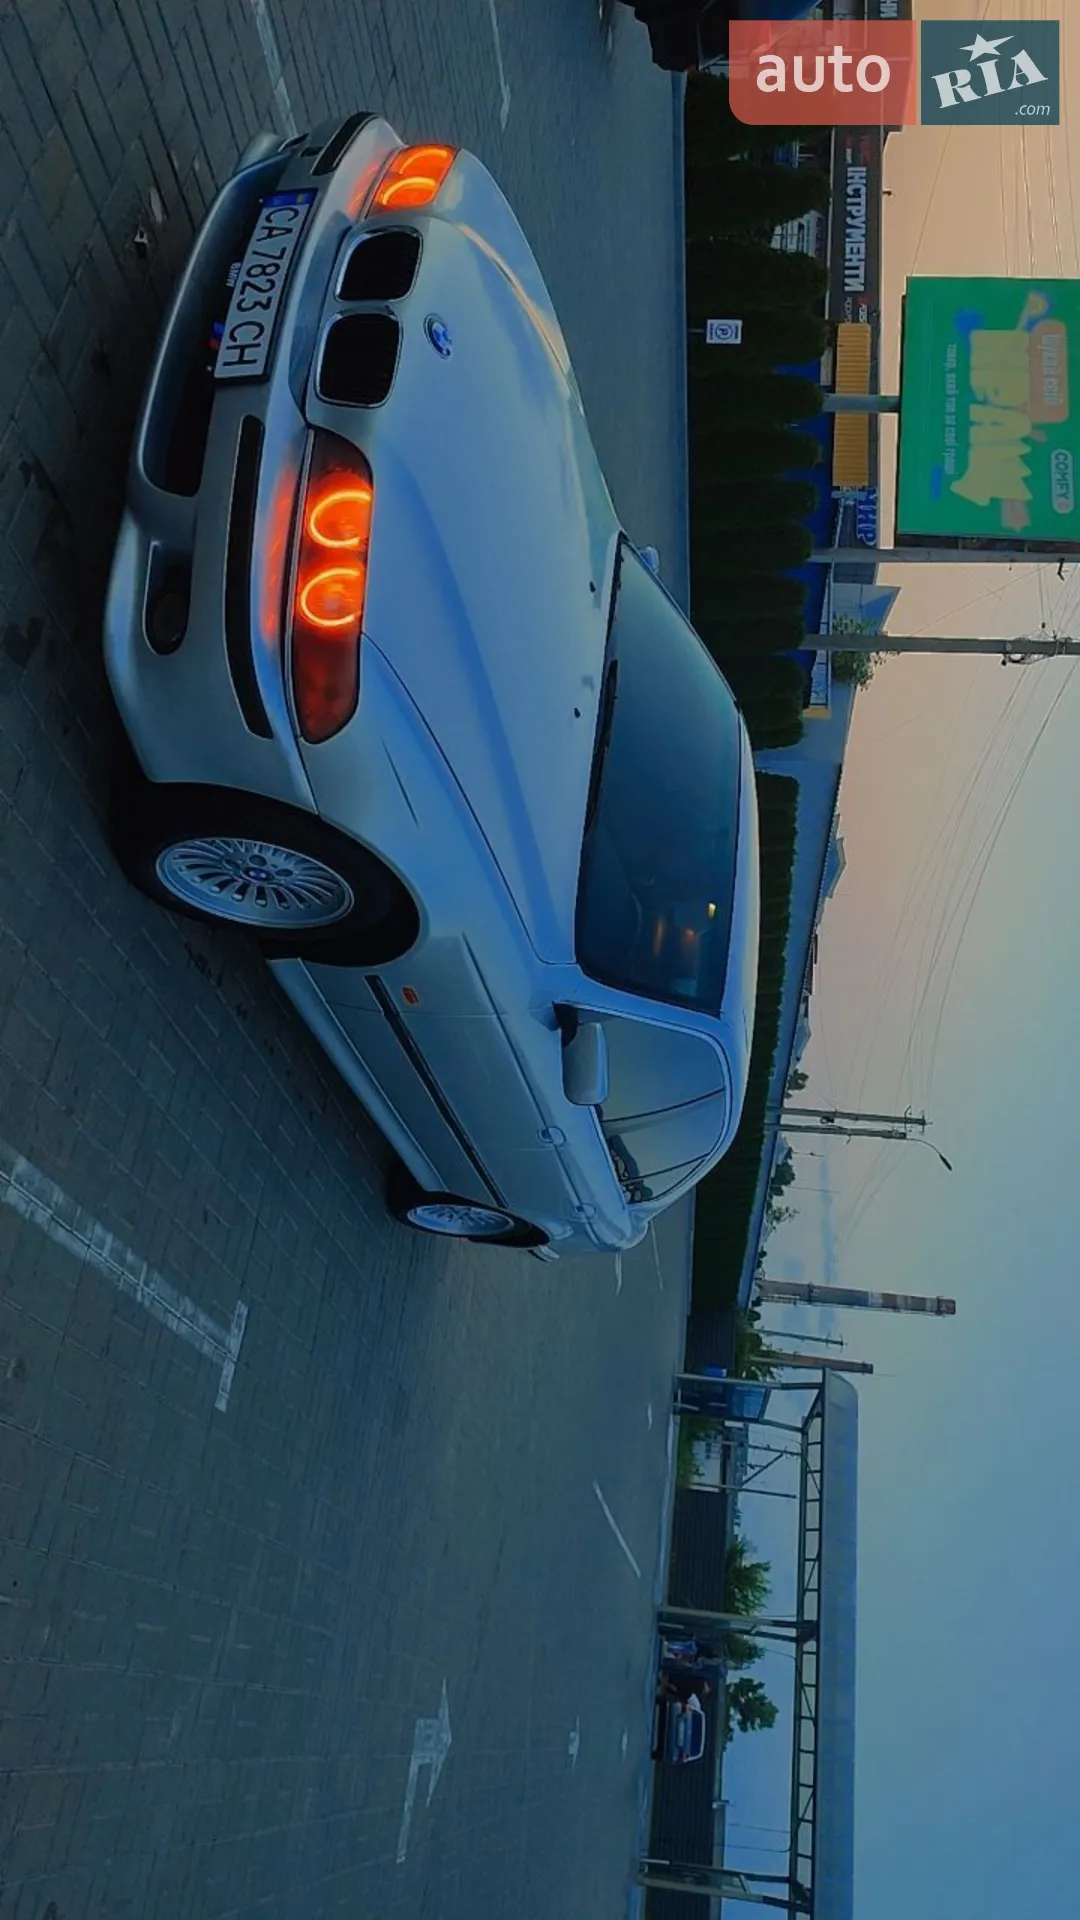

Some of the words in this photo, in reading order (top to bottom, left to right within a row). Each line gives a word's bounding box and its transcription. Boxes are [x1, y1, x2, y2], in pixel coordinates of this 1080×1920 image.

[256, 206, 299, 242] CA
[844, 166, 867, 292] ІНСТРУМЕНТИ
[236, 247, 287, 312] 7823
[222, 321, 265, 366] CH
[1055, 453, 1069, 500] COMFY
